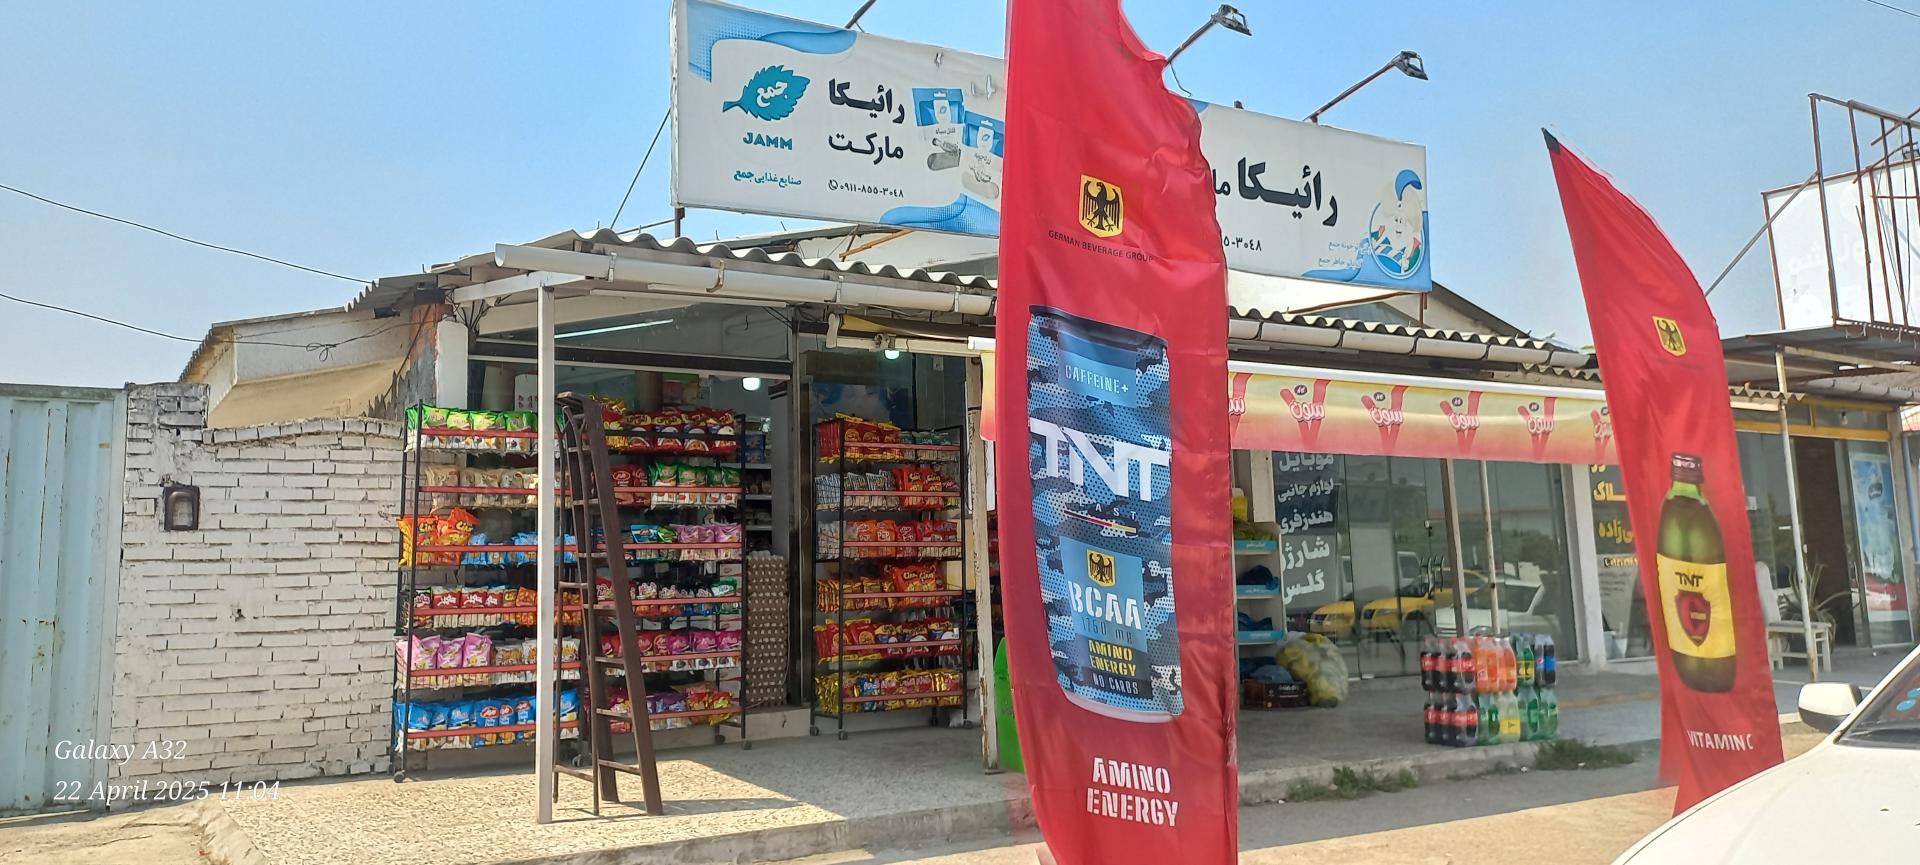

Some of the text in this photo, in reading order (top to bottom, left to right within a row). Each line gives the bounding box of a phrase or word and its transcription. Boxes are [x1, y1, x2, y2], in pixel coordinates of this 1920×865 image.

[757, 81, 788, 108] جمع
[829, 78, 905, 124] رائیکا
[743, 132, 793, 151] JAMM
[828, 132, 904, 165] مارکت
[734, 170, 802, 188] صنایع غذایی جمع
[1212, 157, 1338, 227] رائیکا ما
[1048, 229, 1154, 262] GERMAN BEVERAGE GROUP
[1065, 364, 1130, 395] CAFFEINE+
[1029, 416, 1170, 502] TNT
[1279, 452, 1334, 472] موبایل
[1278, 477, 1334, 503] لوازم جانبی
[1593, 480, 1627, 502] لاک
[1280, 508, 1334, 535] هندزفری
[1675, 571, 1704, 587] TNT
[1067, 580, 1142, 630] BCAA
[1082, 616, 1107, 636] 1750
[1089, 639, 1133, 662] AMINO
[1089, 655, 1137, 677] ENERGY
[1092, 672, 1139, 695] NO CARBS
[1687, 730, 1746, 751] VITAMIN
[1092, 757, 1172, 794] AMINO
[1086, 787, 1179, 827] ENERGY
